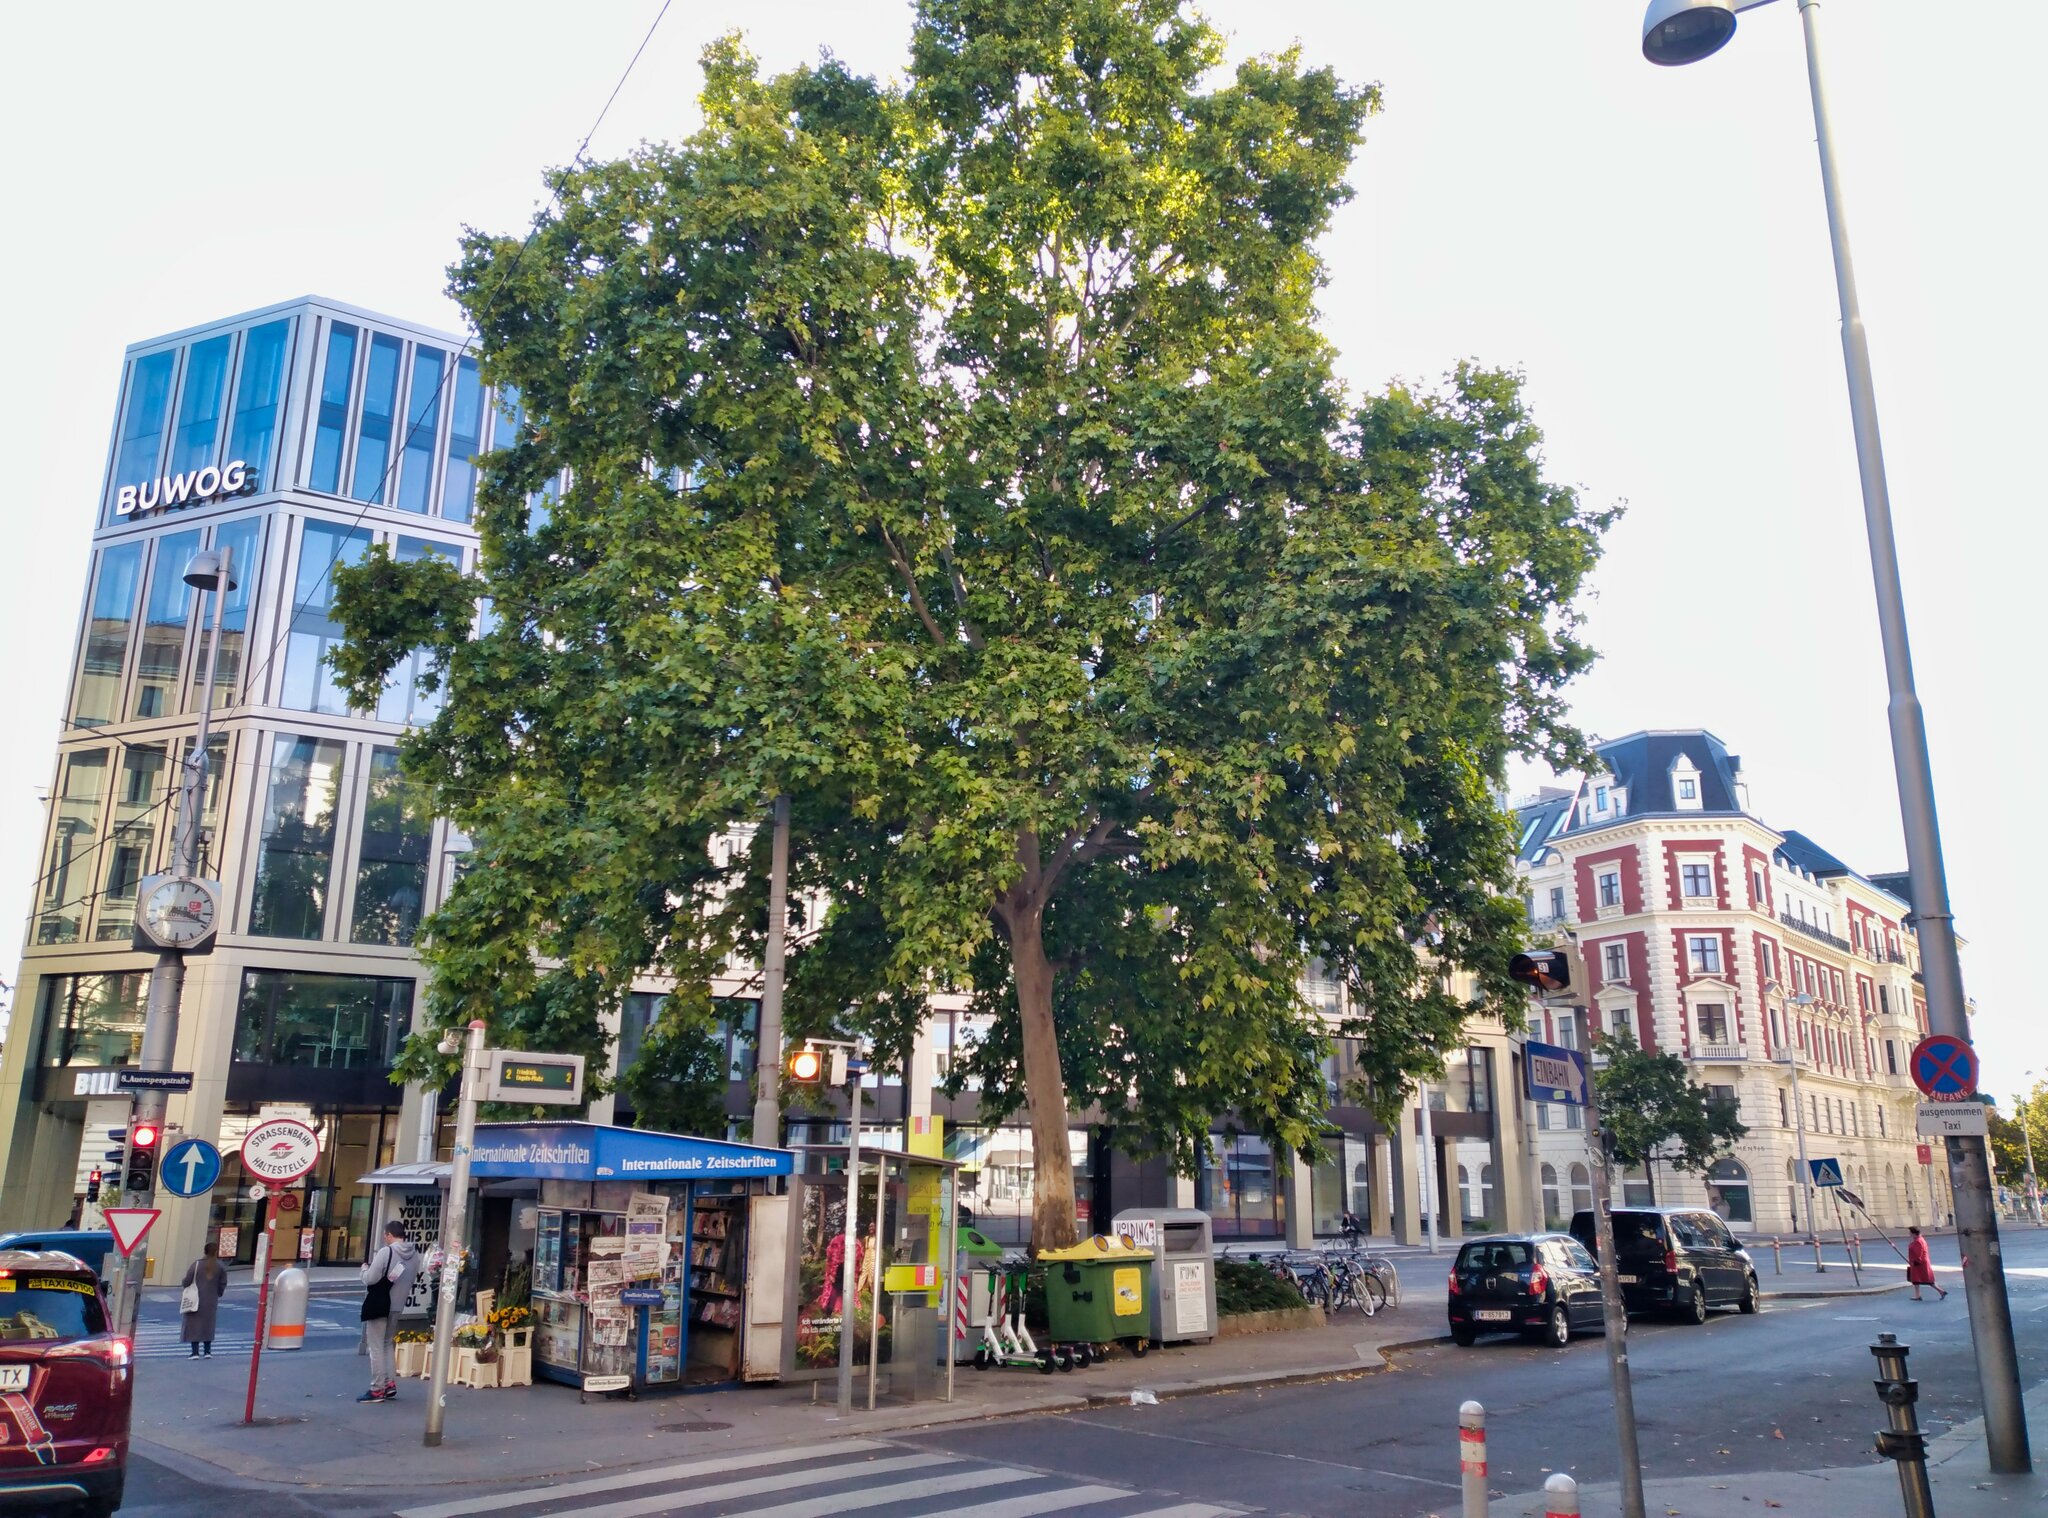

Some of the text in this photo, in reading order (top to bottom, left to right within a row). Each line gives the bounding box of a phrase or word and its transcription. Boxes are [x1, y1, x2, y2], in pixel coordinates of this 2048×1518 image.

[116, 460, 246, 516] BUWOG
[1538, 962, 1549, 973] 31
[505, 1068, 512, 1080] 2
[566, 1072, 572, 1083] 2
[1534, 1059, 1570, 1088] EINBAHN
[74, 1072, 134, 1095] BILL
[1930, 1089, 1968, 1101] ANFANG
[1920, 1108, 1982, 1118] ausgenommen
[1943, 1121, 1962, 1130] Taxi
[251, 1126, 313, 1148] STRASSENBAHN
[471, 1143, 590, 1165] Internationale Zeitschriften
[252, 1156, 308, 1175] HALTESTELLE
[622, 1154, 777, 1171] Internationale Zeitschriften
[253, 1188, 261, 1197] 2
[399, 1207, 422, 1218] YOU
[44, 1279, 66, 1288] TAXI
[2, 1369, 23, 1385] TX
